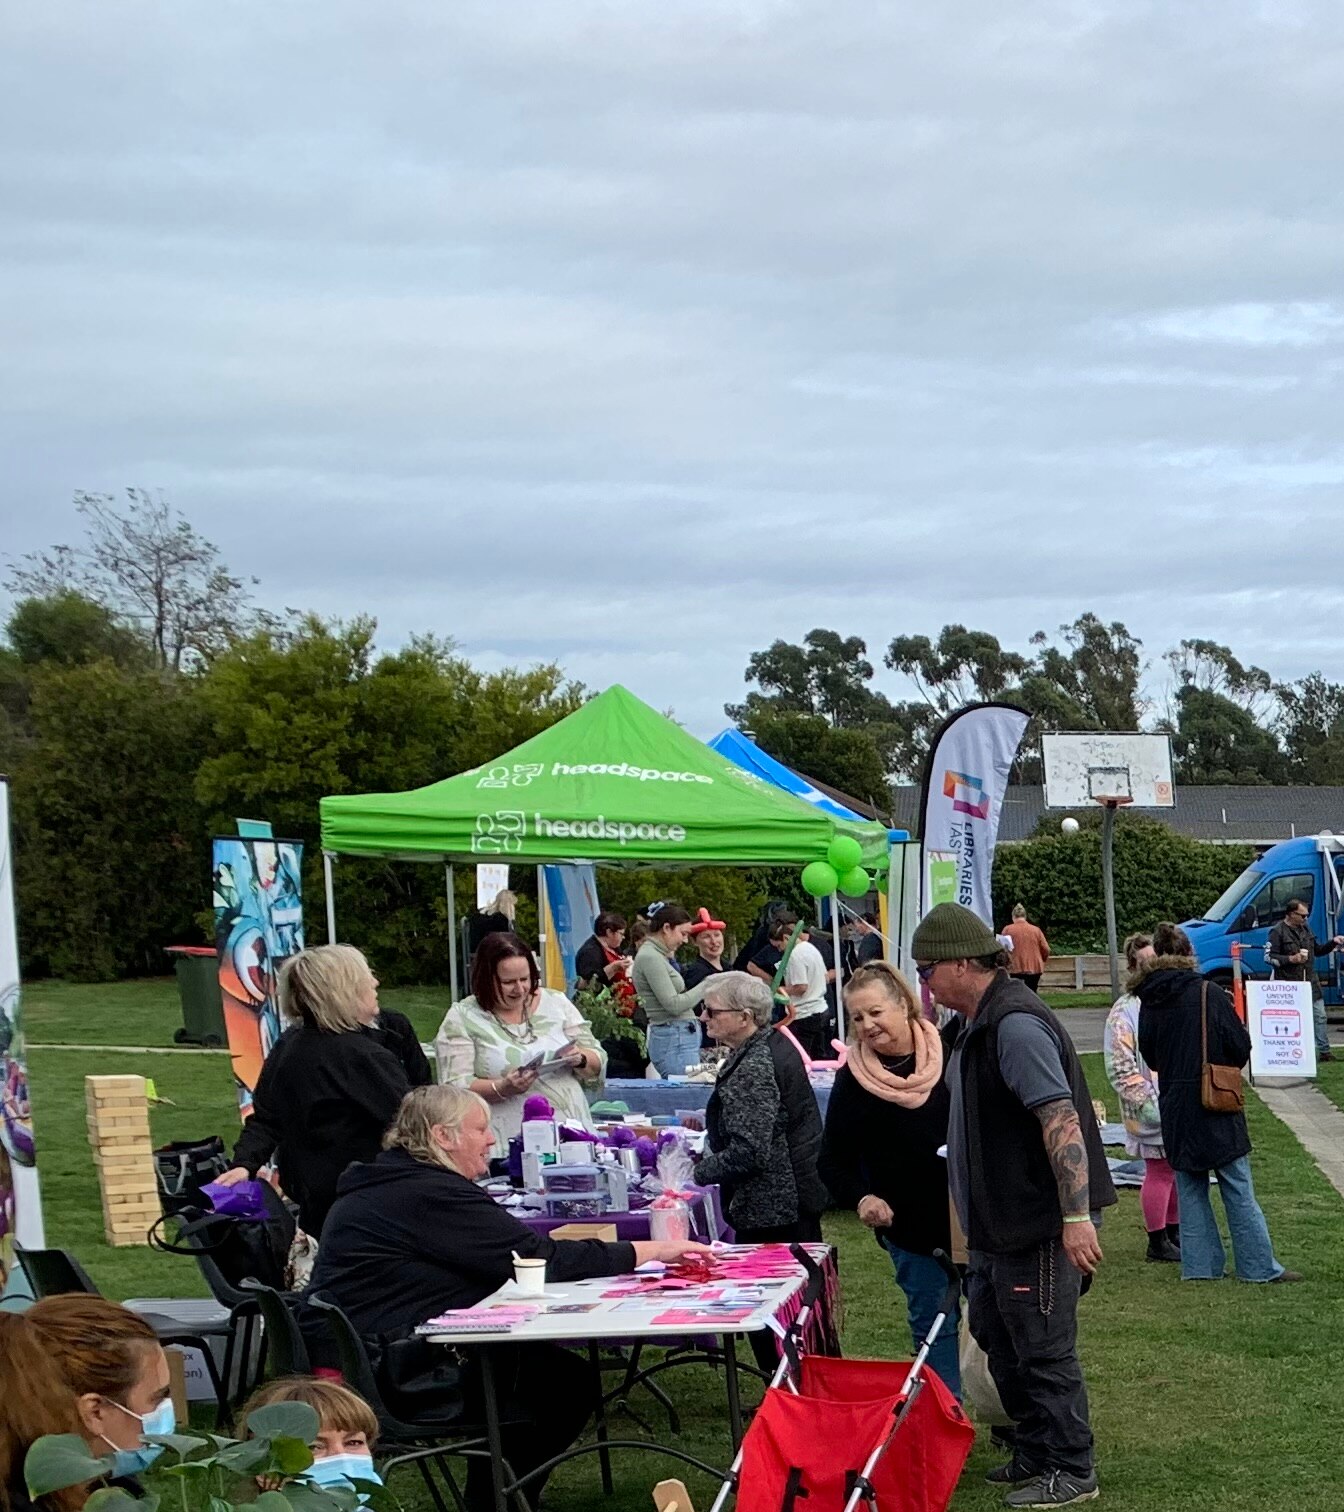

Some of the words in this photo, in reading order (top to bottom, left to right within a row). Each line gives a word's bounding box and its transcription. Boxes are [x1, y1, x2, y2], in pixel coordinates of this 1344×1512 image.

[551, 761, 715, 785] headspace
[534, 812, 687, 845] headspace
[959, 821, 975, 907] LIBRARIES
[1261, 984, 1298, 992] CAUTION
